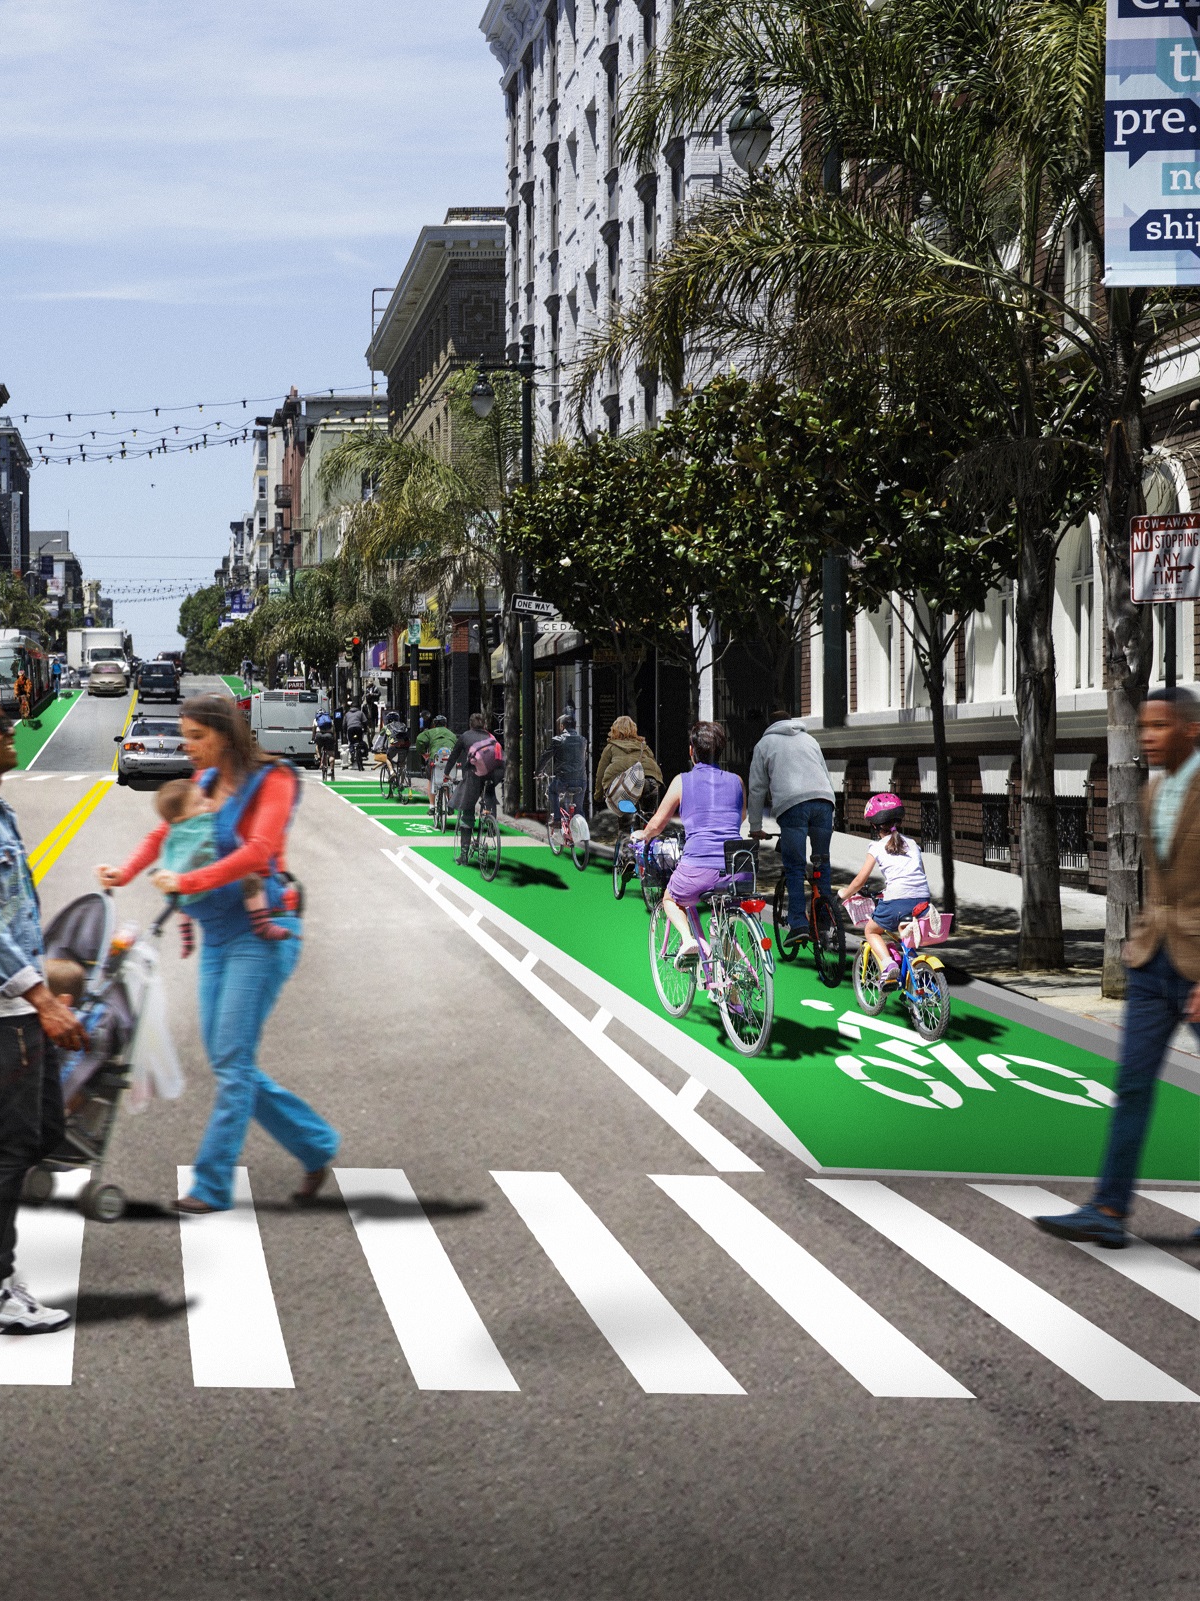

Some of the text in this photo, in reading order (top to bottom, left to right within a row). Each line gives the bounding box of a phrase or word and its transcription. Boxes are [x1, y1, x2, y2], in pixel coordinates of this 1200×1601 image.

[1113, 106, 1197, 146] pre.
[1137, 517, 1196, 530] TOW-AWAY
[1133, 530, 1199, 550] NO STOPPING
[1154, 553, 1180, 567] ANY
[1152, 570, 1183, 585] TIME
[517, 600, 551, 611] ONE WAY
[288, 681, 304, 689] PARK
